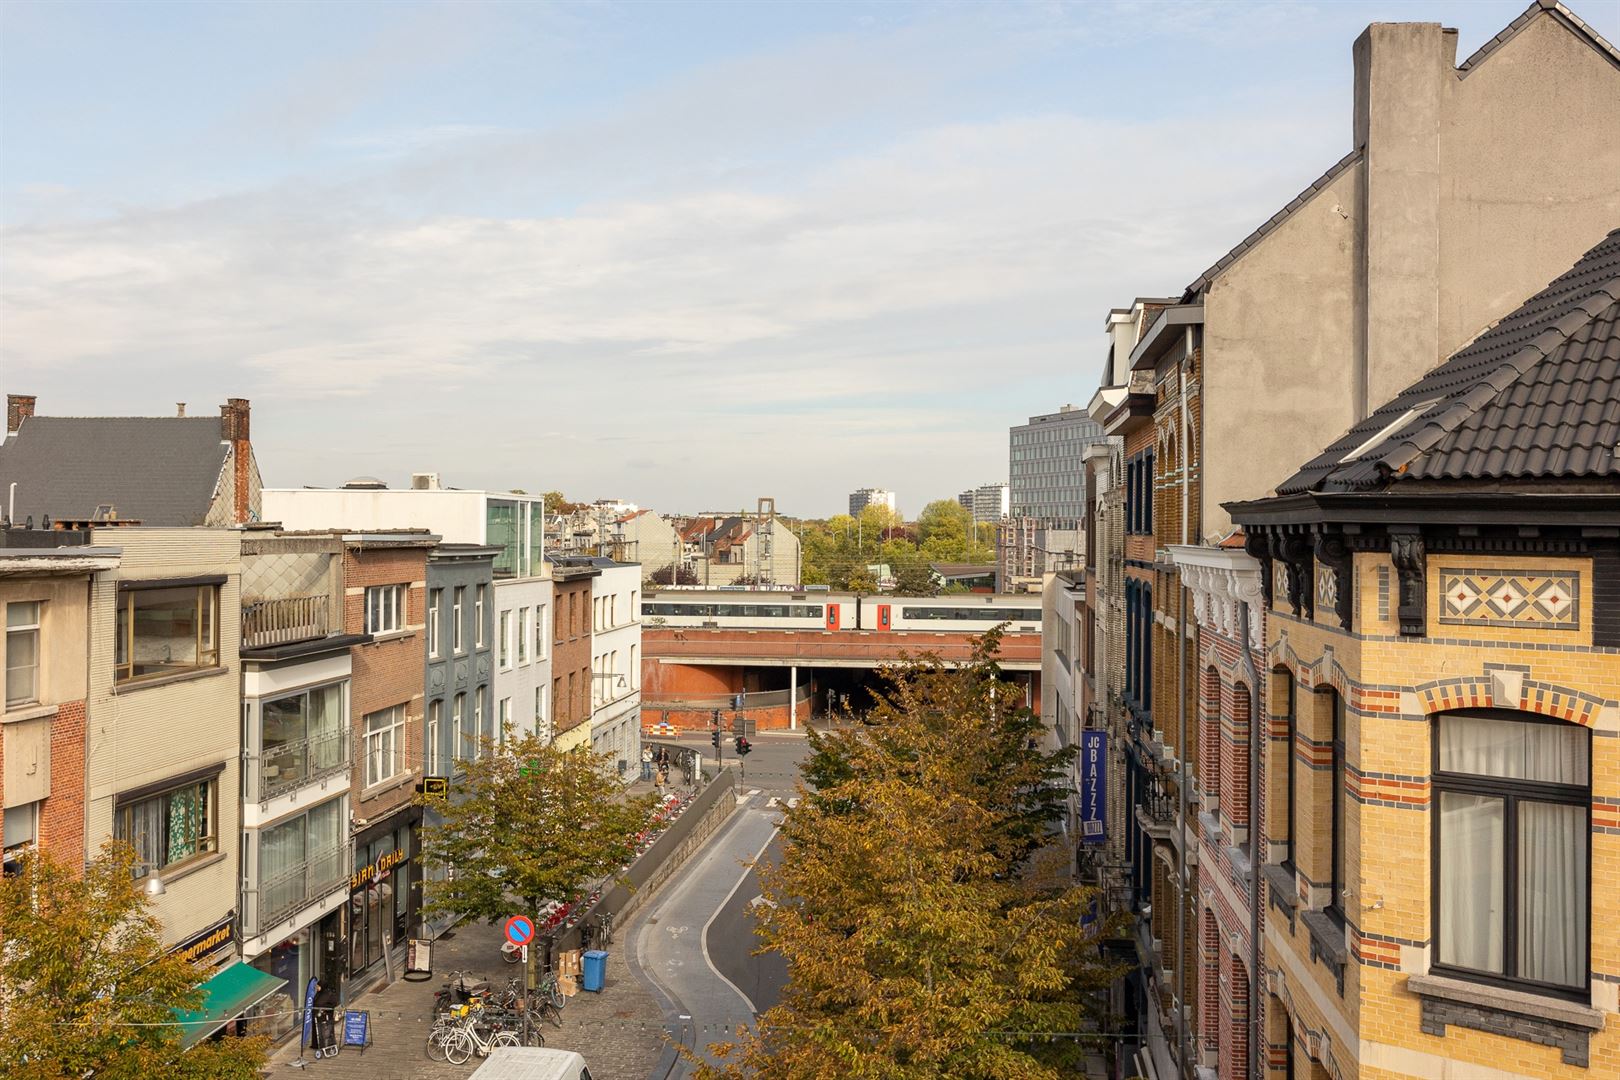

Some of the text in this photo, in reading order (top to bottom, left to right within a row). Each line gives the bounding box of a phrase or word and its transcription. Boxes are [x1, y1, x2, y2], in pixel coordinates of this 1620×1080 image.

[1088, 736, 1100, 749] JC
[1090, 749, 1098, 821] BAZZZ
[351, 848, 404, 889] SIAN DAILY
[180, 923, 231, 963] permarket
